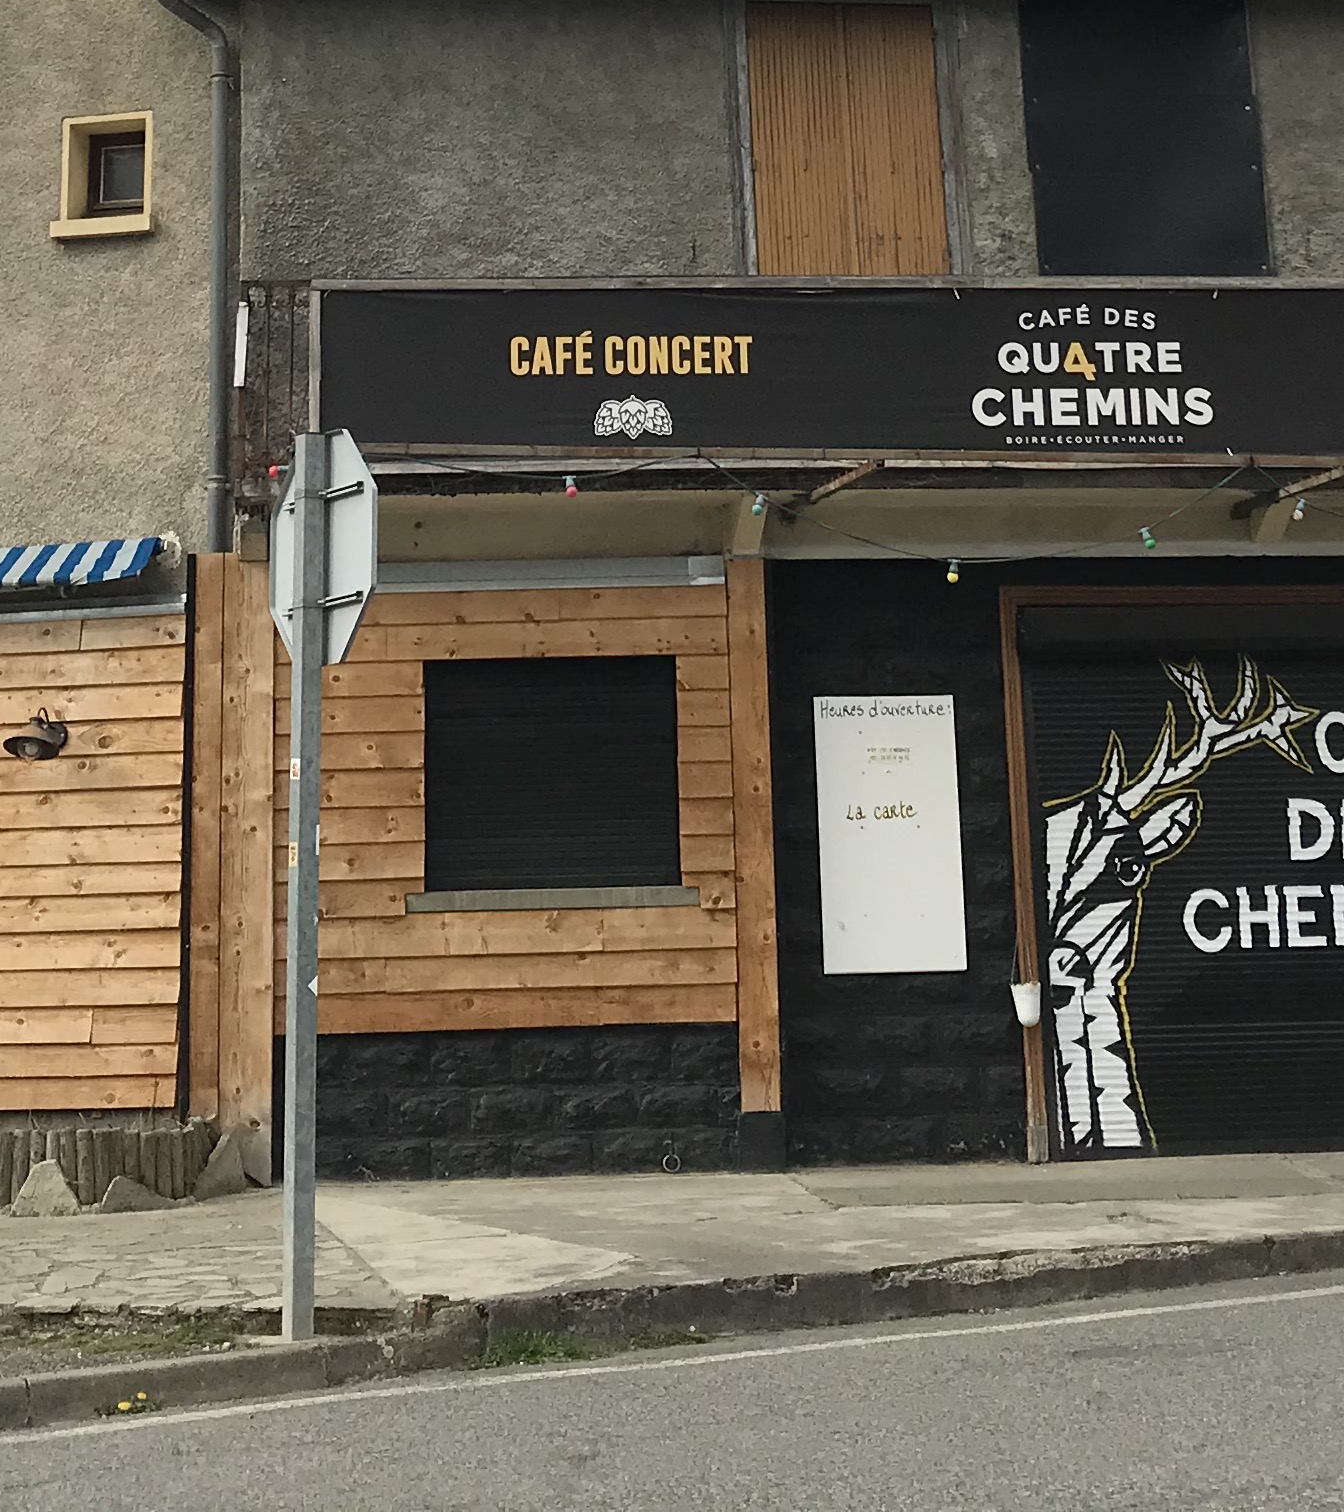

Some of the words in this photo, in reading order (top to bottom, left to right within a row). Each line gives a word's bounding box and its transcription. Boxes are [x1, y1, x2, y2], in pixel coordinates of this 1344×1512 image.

[1018, 303, 1090, 330] CAFÉ
[1104, 307, 1156, 330] DES
[510, 330, 594, 376] CAFÉ
[604, 335, 753, 375] CONCERT
[971, 387, 1214, 426] CHEMINS
